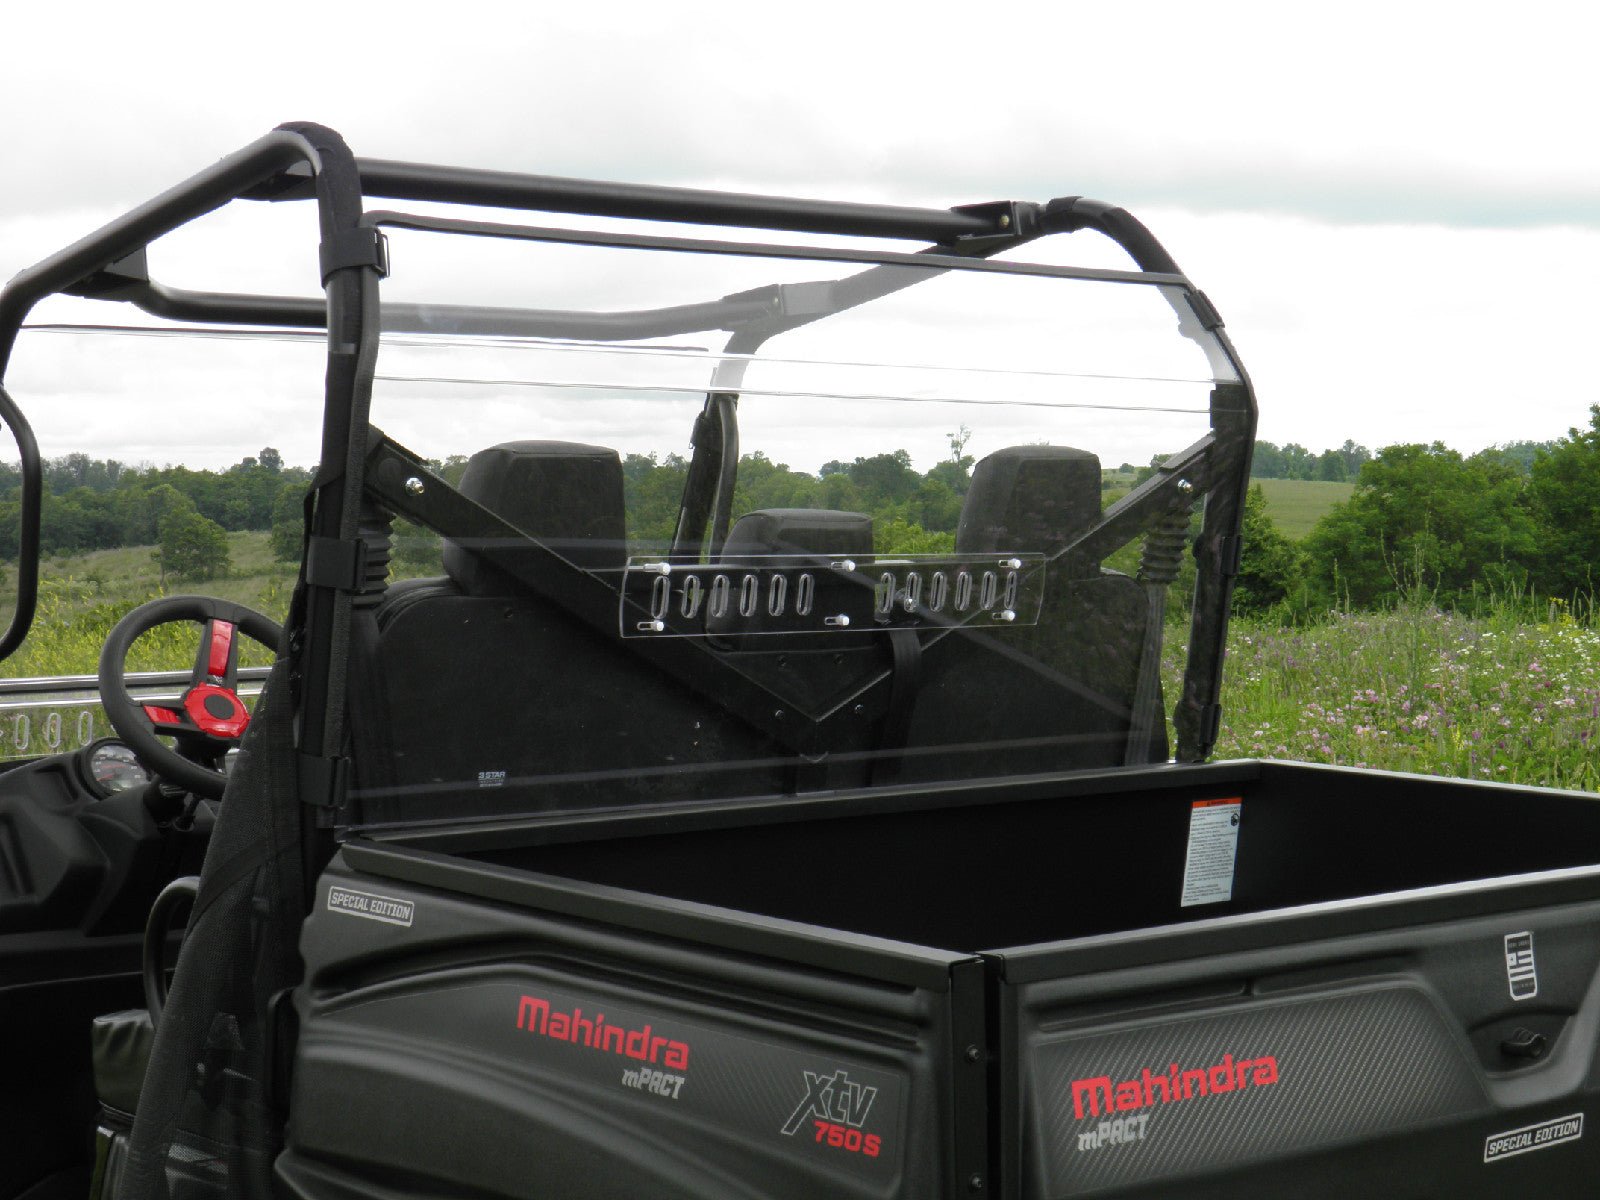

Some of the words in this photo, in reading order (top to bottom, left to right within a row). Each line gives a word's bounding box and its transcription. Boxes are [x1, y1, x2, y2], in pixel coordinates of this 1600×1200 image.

[331, 892, 369, 911] SPECIAL
[370, 900, 411, 919] EDITION
[516, 995, 690, 1071] Mahindra
[621, 1066, 686, 1100] mPACT
[1071, 1053, 1279, 1120] Mahindra
[1077, 1113, 1150, 1151] mPACT
[1488, 1132, 1532, 1155] SPECIAL
[1534, 1120, 1579, 1143] EDITION
